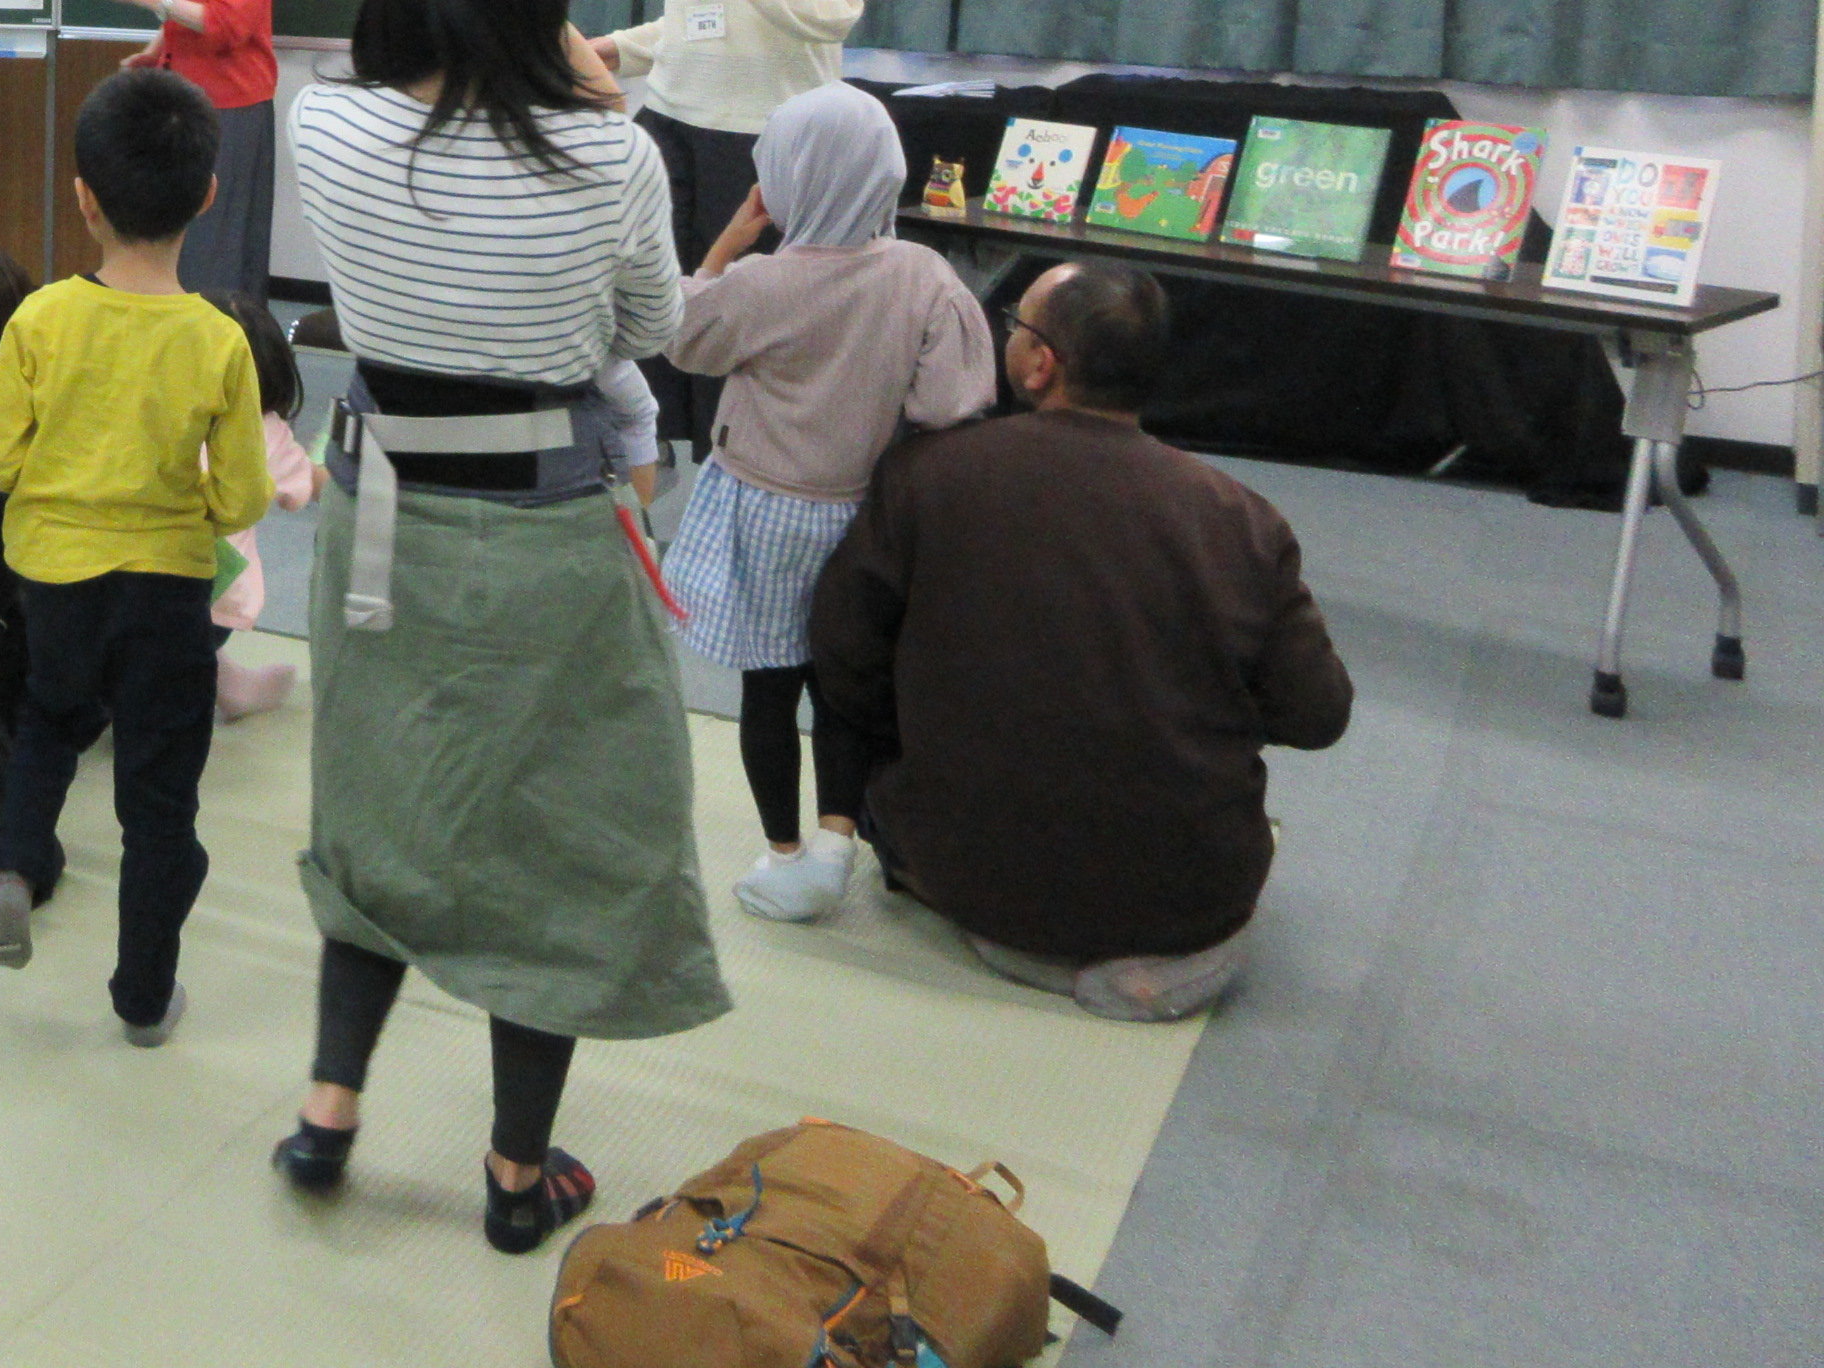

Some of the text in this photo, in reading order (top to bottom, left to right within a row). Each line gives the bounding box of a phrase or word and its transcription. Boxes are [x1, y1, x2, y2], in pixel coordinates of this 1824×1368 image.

[1427, 130, 1526, 176] Shark
[1255, 161, 1360, 194] green
[1617, 157, 1659, 187] DO
[1412, 220, 1506, 256] Park!
